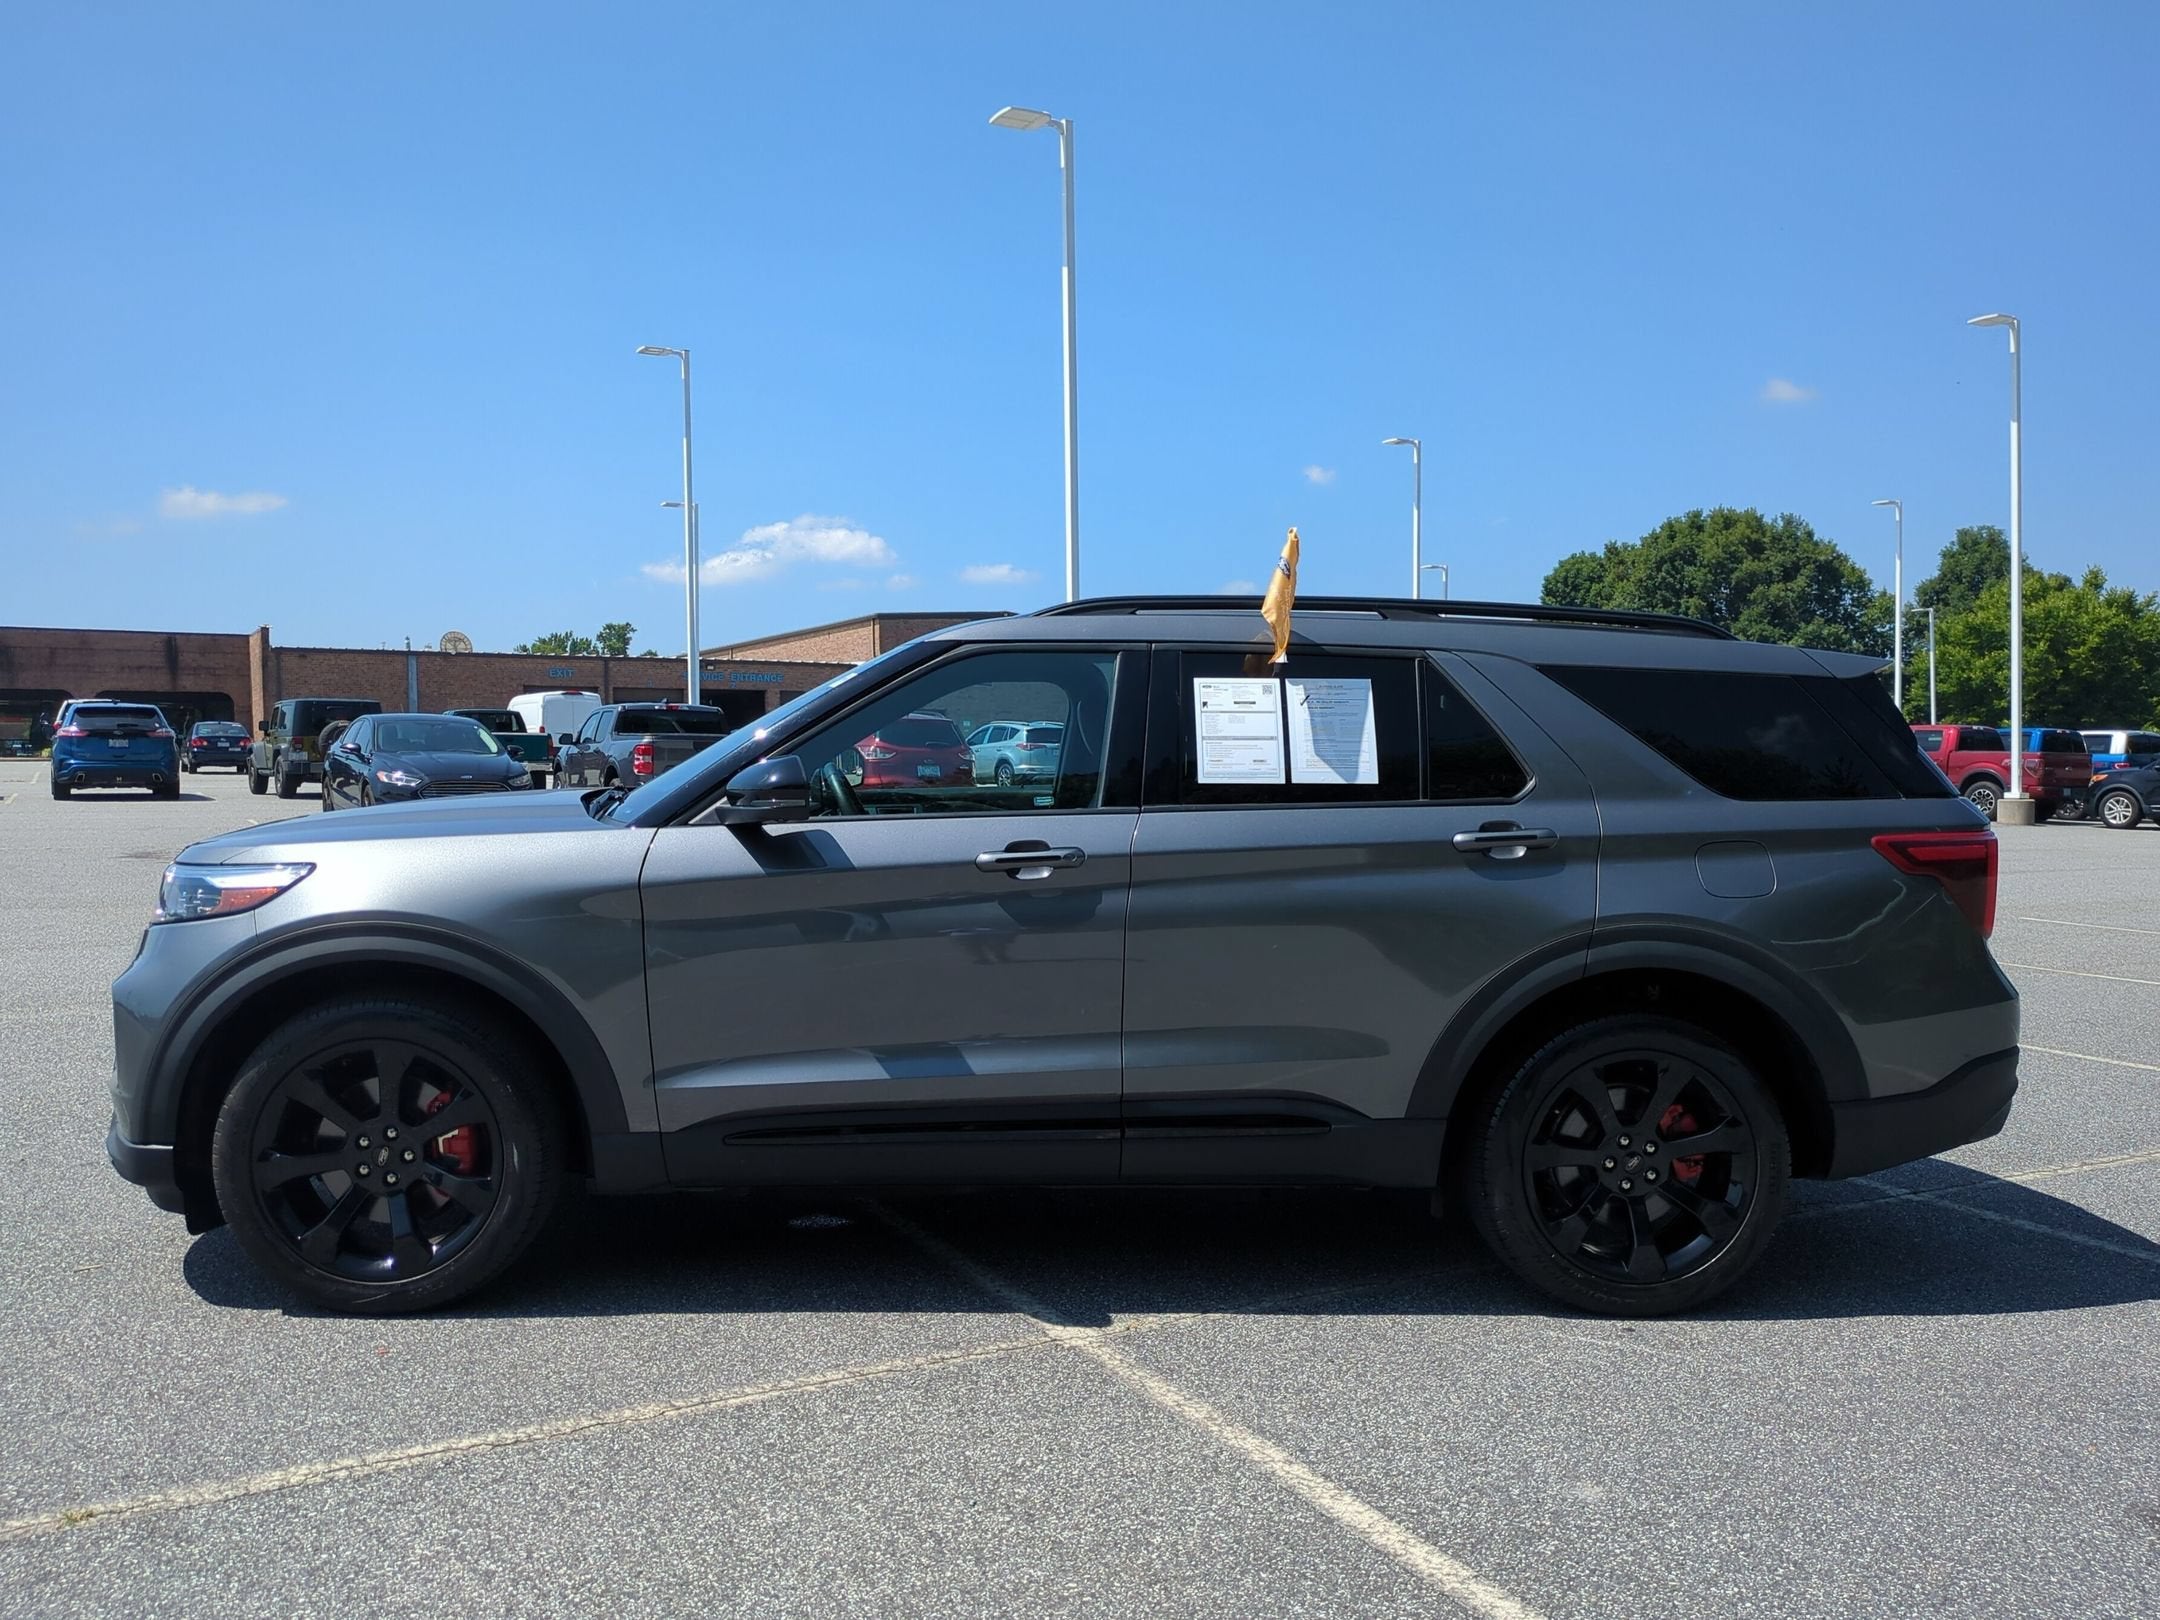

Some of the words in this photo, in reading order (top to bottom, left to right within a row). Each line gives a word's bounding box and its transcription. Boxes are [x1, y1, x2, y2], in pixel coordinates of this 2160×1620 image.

[549, 667, 575, 678] EXIT
[682, 671, 724, 681] SVICE
[730, 672, 784, 683] ENTRANCE
